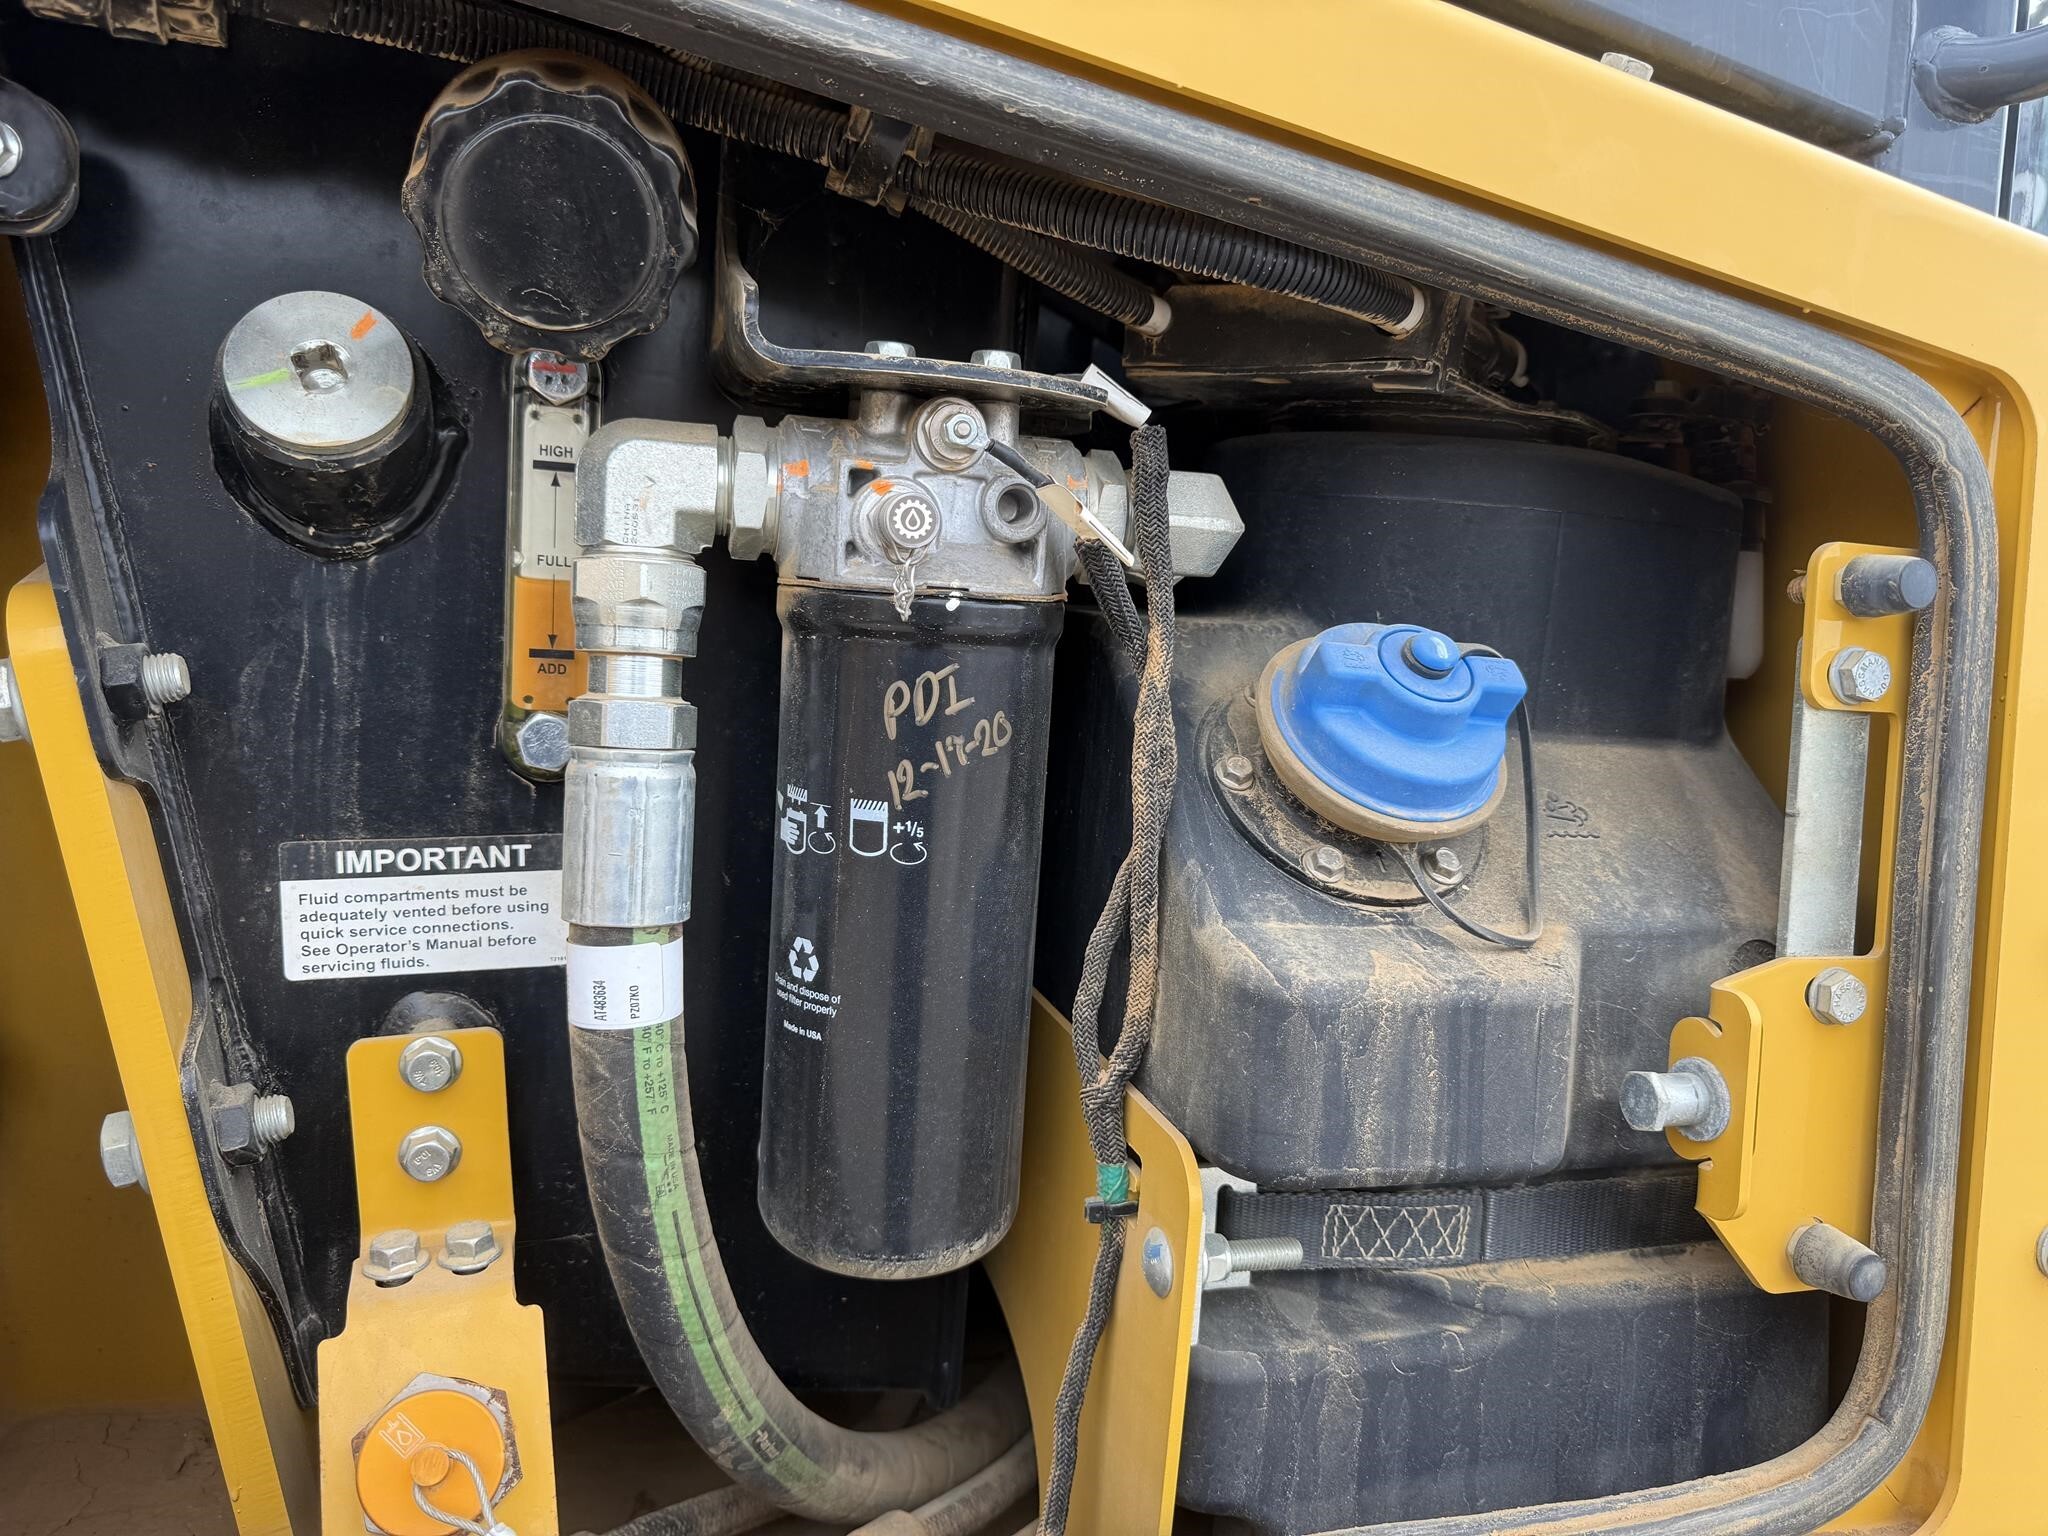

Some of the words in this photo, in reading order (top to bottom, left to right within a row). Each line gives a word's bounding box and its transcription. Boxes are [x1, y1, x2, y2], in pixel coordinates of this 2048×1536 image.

[538, 444, 574, 458] HIGH
[622, 503, 631, 543] CHINA
[537, 554, 572, 568] FULL
[537, 663, 567, 675] ADD
[883, 663, 976, 740] PDI
[335, 843, 532, 875] IMPORTANT
[298, 891, 339, 906] Fluid
[344, 888, 460, 906] compartments
[465, 886, 504, 899] must
[509, 885, 528, 897] be
[299, 907, 388, 924] adequately
[393, 905, 446, 919] vented
[452, 903, 502, 916] before
[507, 901, 549, 914] using
[300, 925, 344, 942] quick
[349, 924, 407, 937] service
[412, 919, 515, 935] connections.
[301, 944, 331, 957] See
[336, 939, 420, 958] Operator's
[426, 936, 482, 951] Manual
[488, 934, 537, 948] before
[302, 958, 375, 974] servicing
[380, 956, 430, 970] fluids.
[787, 980, 798, 993] and
[799, 986, 829, 1002] dispose
[831, 994, 842, 1004] of
[789, 993, 802, 1007] filter
[803, 1001, 838, 1018] properly
[783, 1019, 798, 1034] Made
[799, 1026, 805, 1036] in
[806, 1029, 822, 1041] USA
[656, 1043, 665, 1053] C
[643, 1059, 651, 1070] TO
[656, 1056, 663, 1068] TO
[660, 1104, 670, 1114] C
[667, 1134, 675, 1160] MADE
